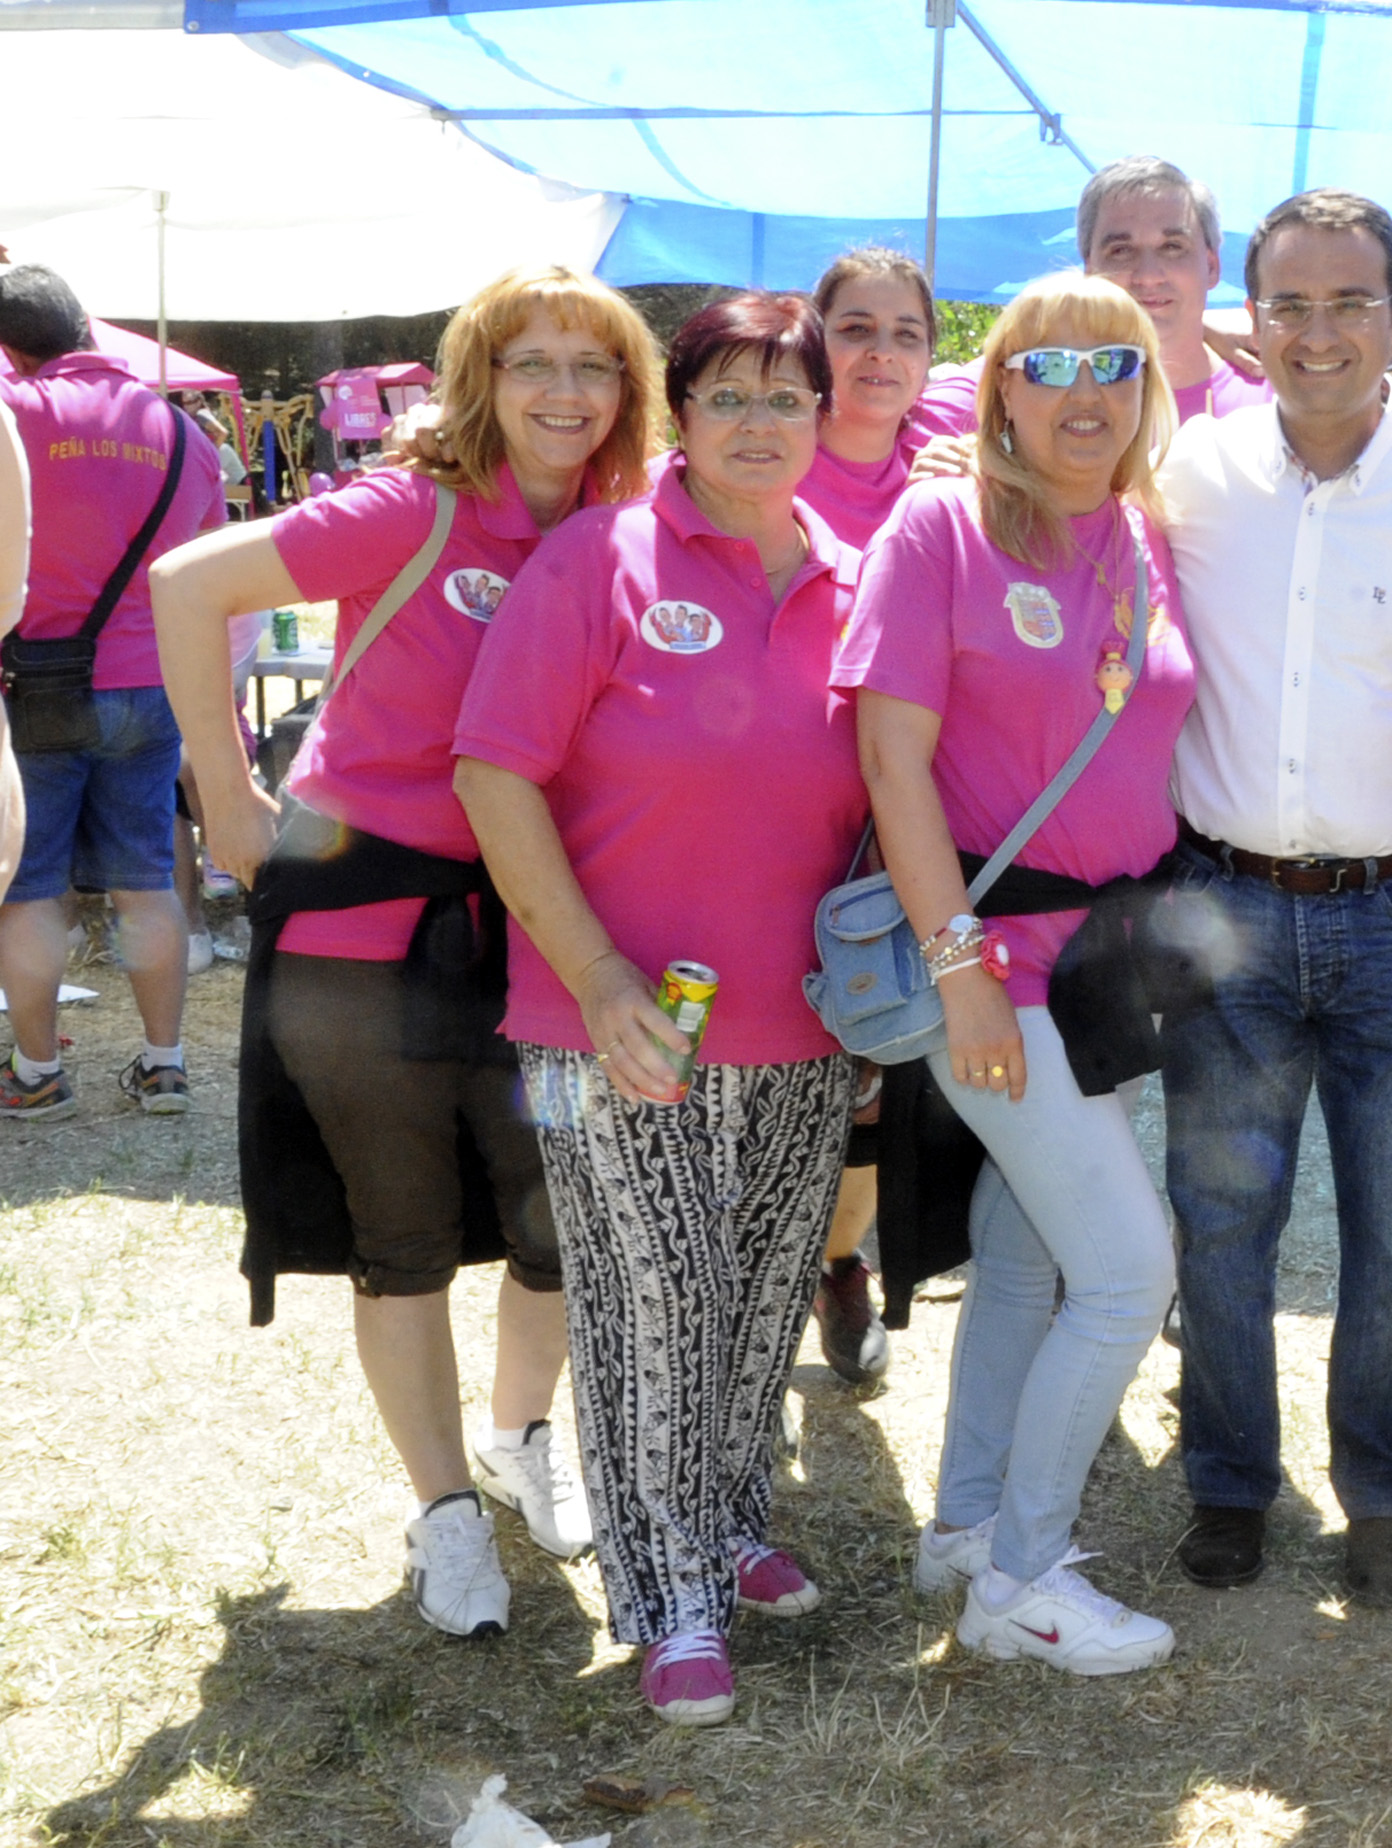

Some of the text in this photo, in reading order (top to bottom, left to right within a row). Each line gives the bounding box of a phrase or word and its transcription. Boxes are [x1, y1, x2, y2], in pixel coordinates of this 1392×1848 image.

[49, 436, 167, 471] PEÑA LOS MIXTOS
